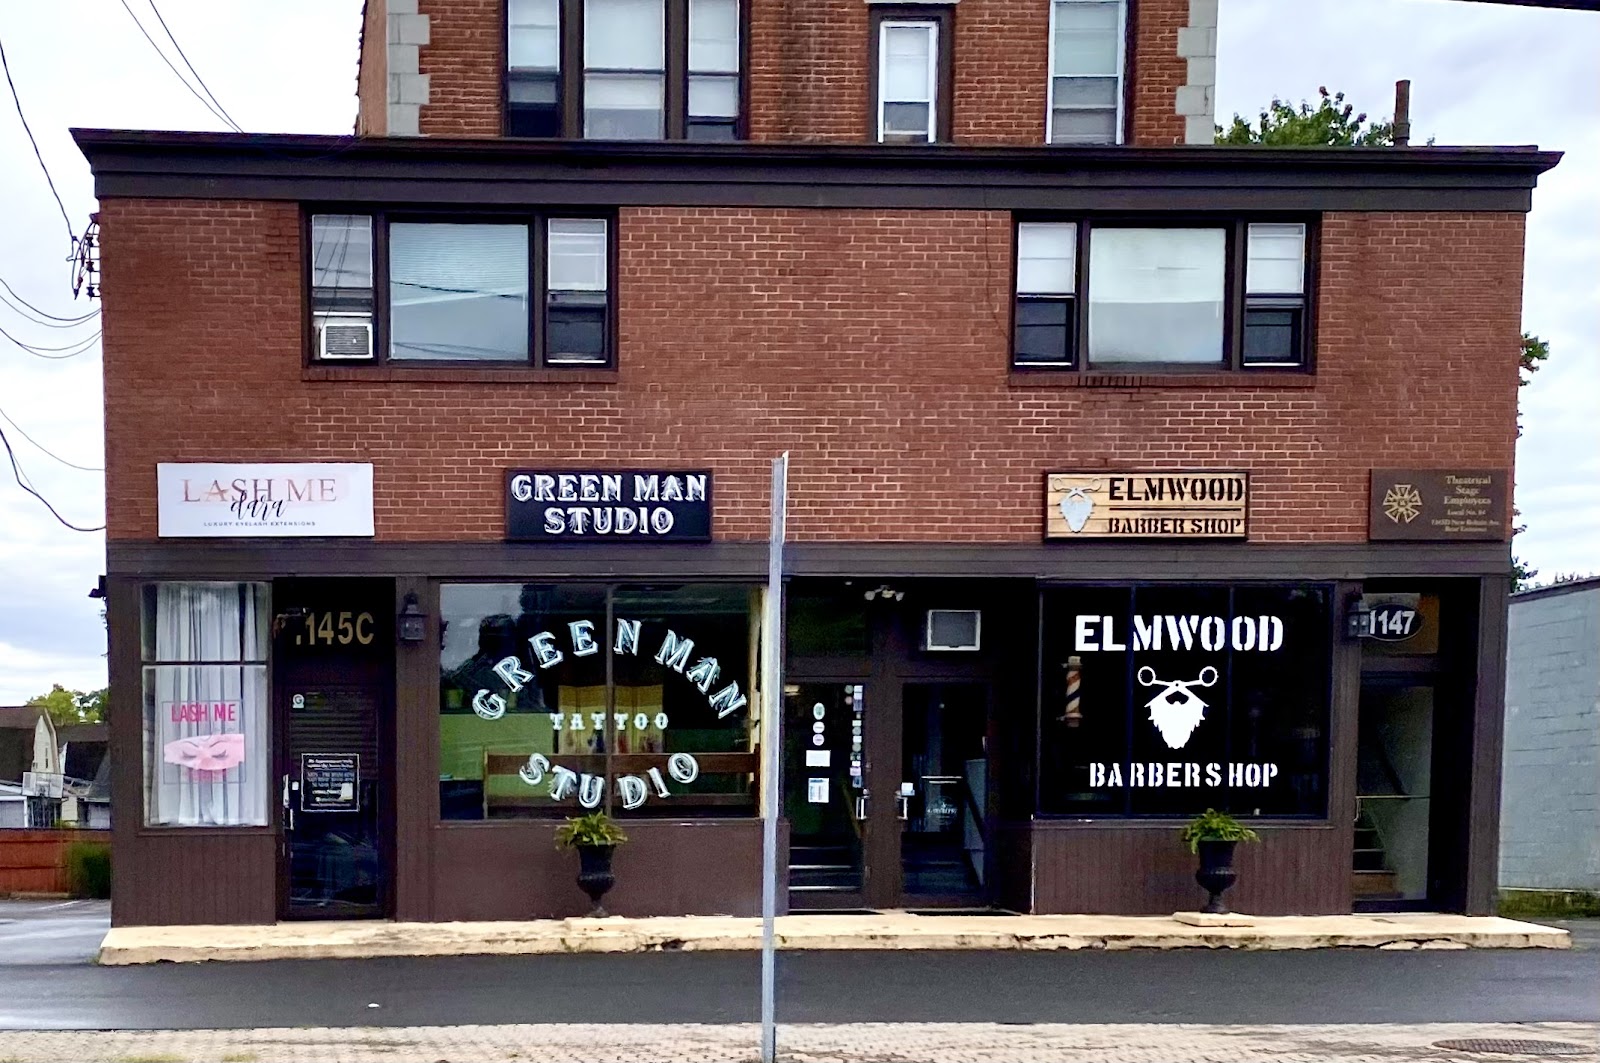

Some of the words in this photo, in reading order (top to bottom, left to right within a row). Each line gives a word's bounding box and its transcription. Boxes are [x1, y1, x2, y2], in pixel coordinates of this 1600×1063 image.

[180, 478, 274, 502] LASH
[286, 478, 337, 502] ME
[510, 474, 623, 502] GREEN
[633, 474, 707, 502] MAN
[1109, 477, 1243, 501] ELMWOOD
[1445, 475, 1492, 485] Theatrical
[1455, 485, 1480, 496] Stage
[230, 489, 287, 521] dara
[1443, 495, 1492, 506] Employees
[543, 507, 675, 534] STUDIO
[1108, 518, 1185, 534] BARBER
[1190, 518, 1242, 534] SHOP
[1075, 615, 1284, 652] ELMWOOD
[1369, 610, 1416, 635] 1147
[472, 618, 642, 721] GREEN
[654, 629, 748, 719] MAN
[171, 703, 209, 723] LASH
[214, 703, 236, 723] ME
[550, 712, 669, 731] TATTOO
[519, 752, 700, 810] STUDIO
[1089, 762, 1201, 788] BARBER
[1205, 762, 1279, 788] SHOP
